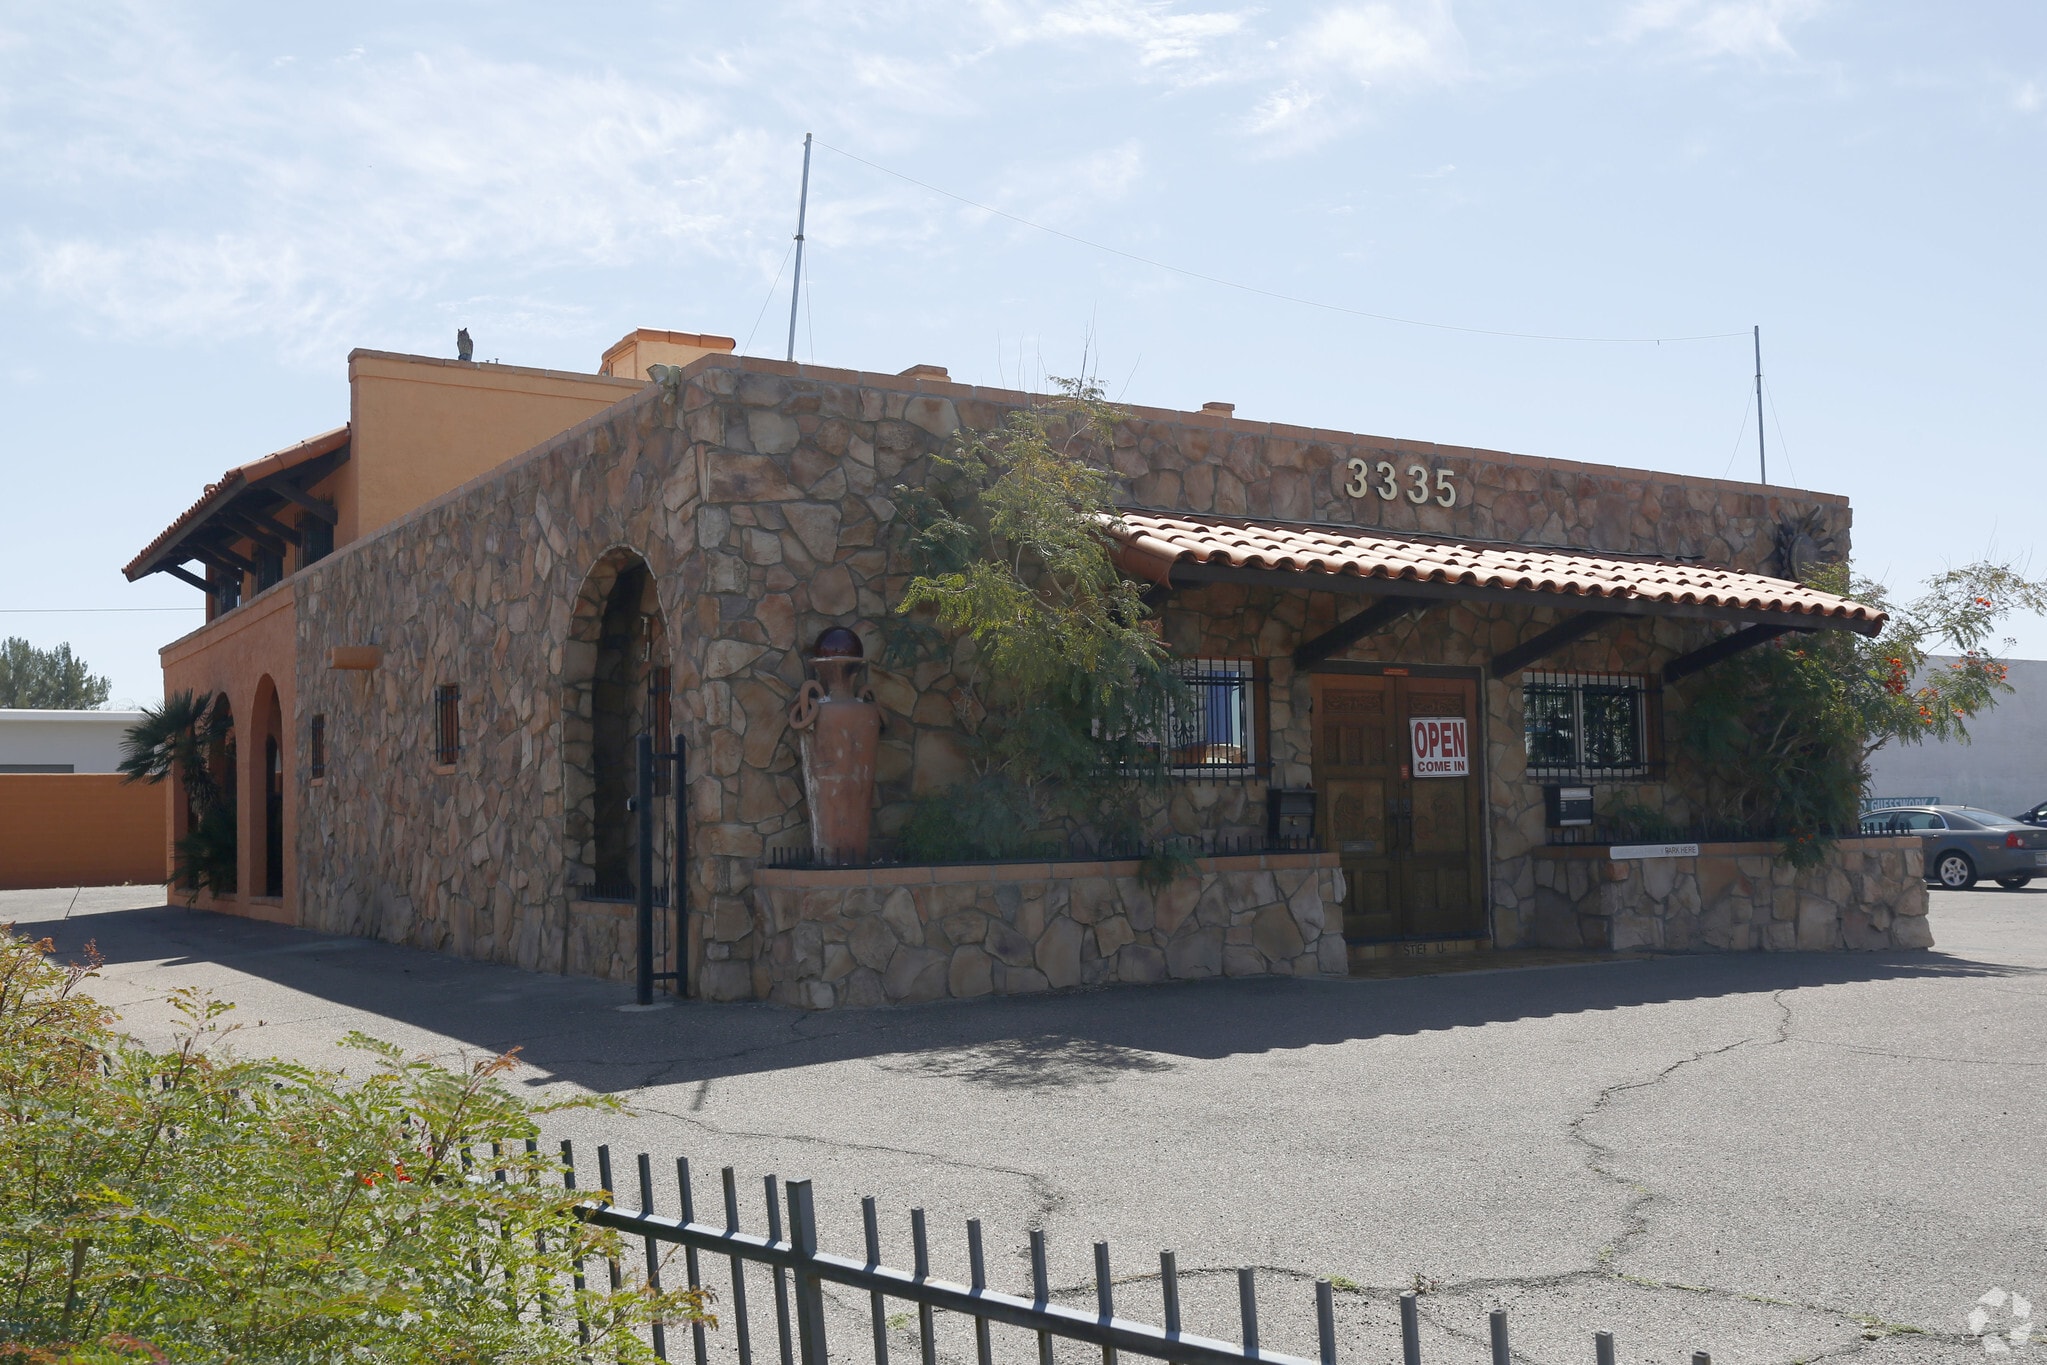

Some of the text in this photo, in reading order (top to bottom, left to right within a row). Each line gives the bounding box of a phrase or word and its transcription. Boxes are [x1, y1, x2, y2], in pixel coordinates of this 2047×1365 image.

[1346, 457, 1457, 508] 3335
[1414, 721, 1466, 759] OPEN
[1417, 761, 1452, 772] COME
[1454, 761, 1465, 771] IN
